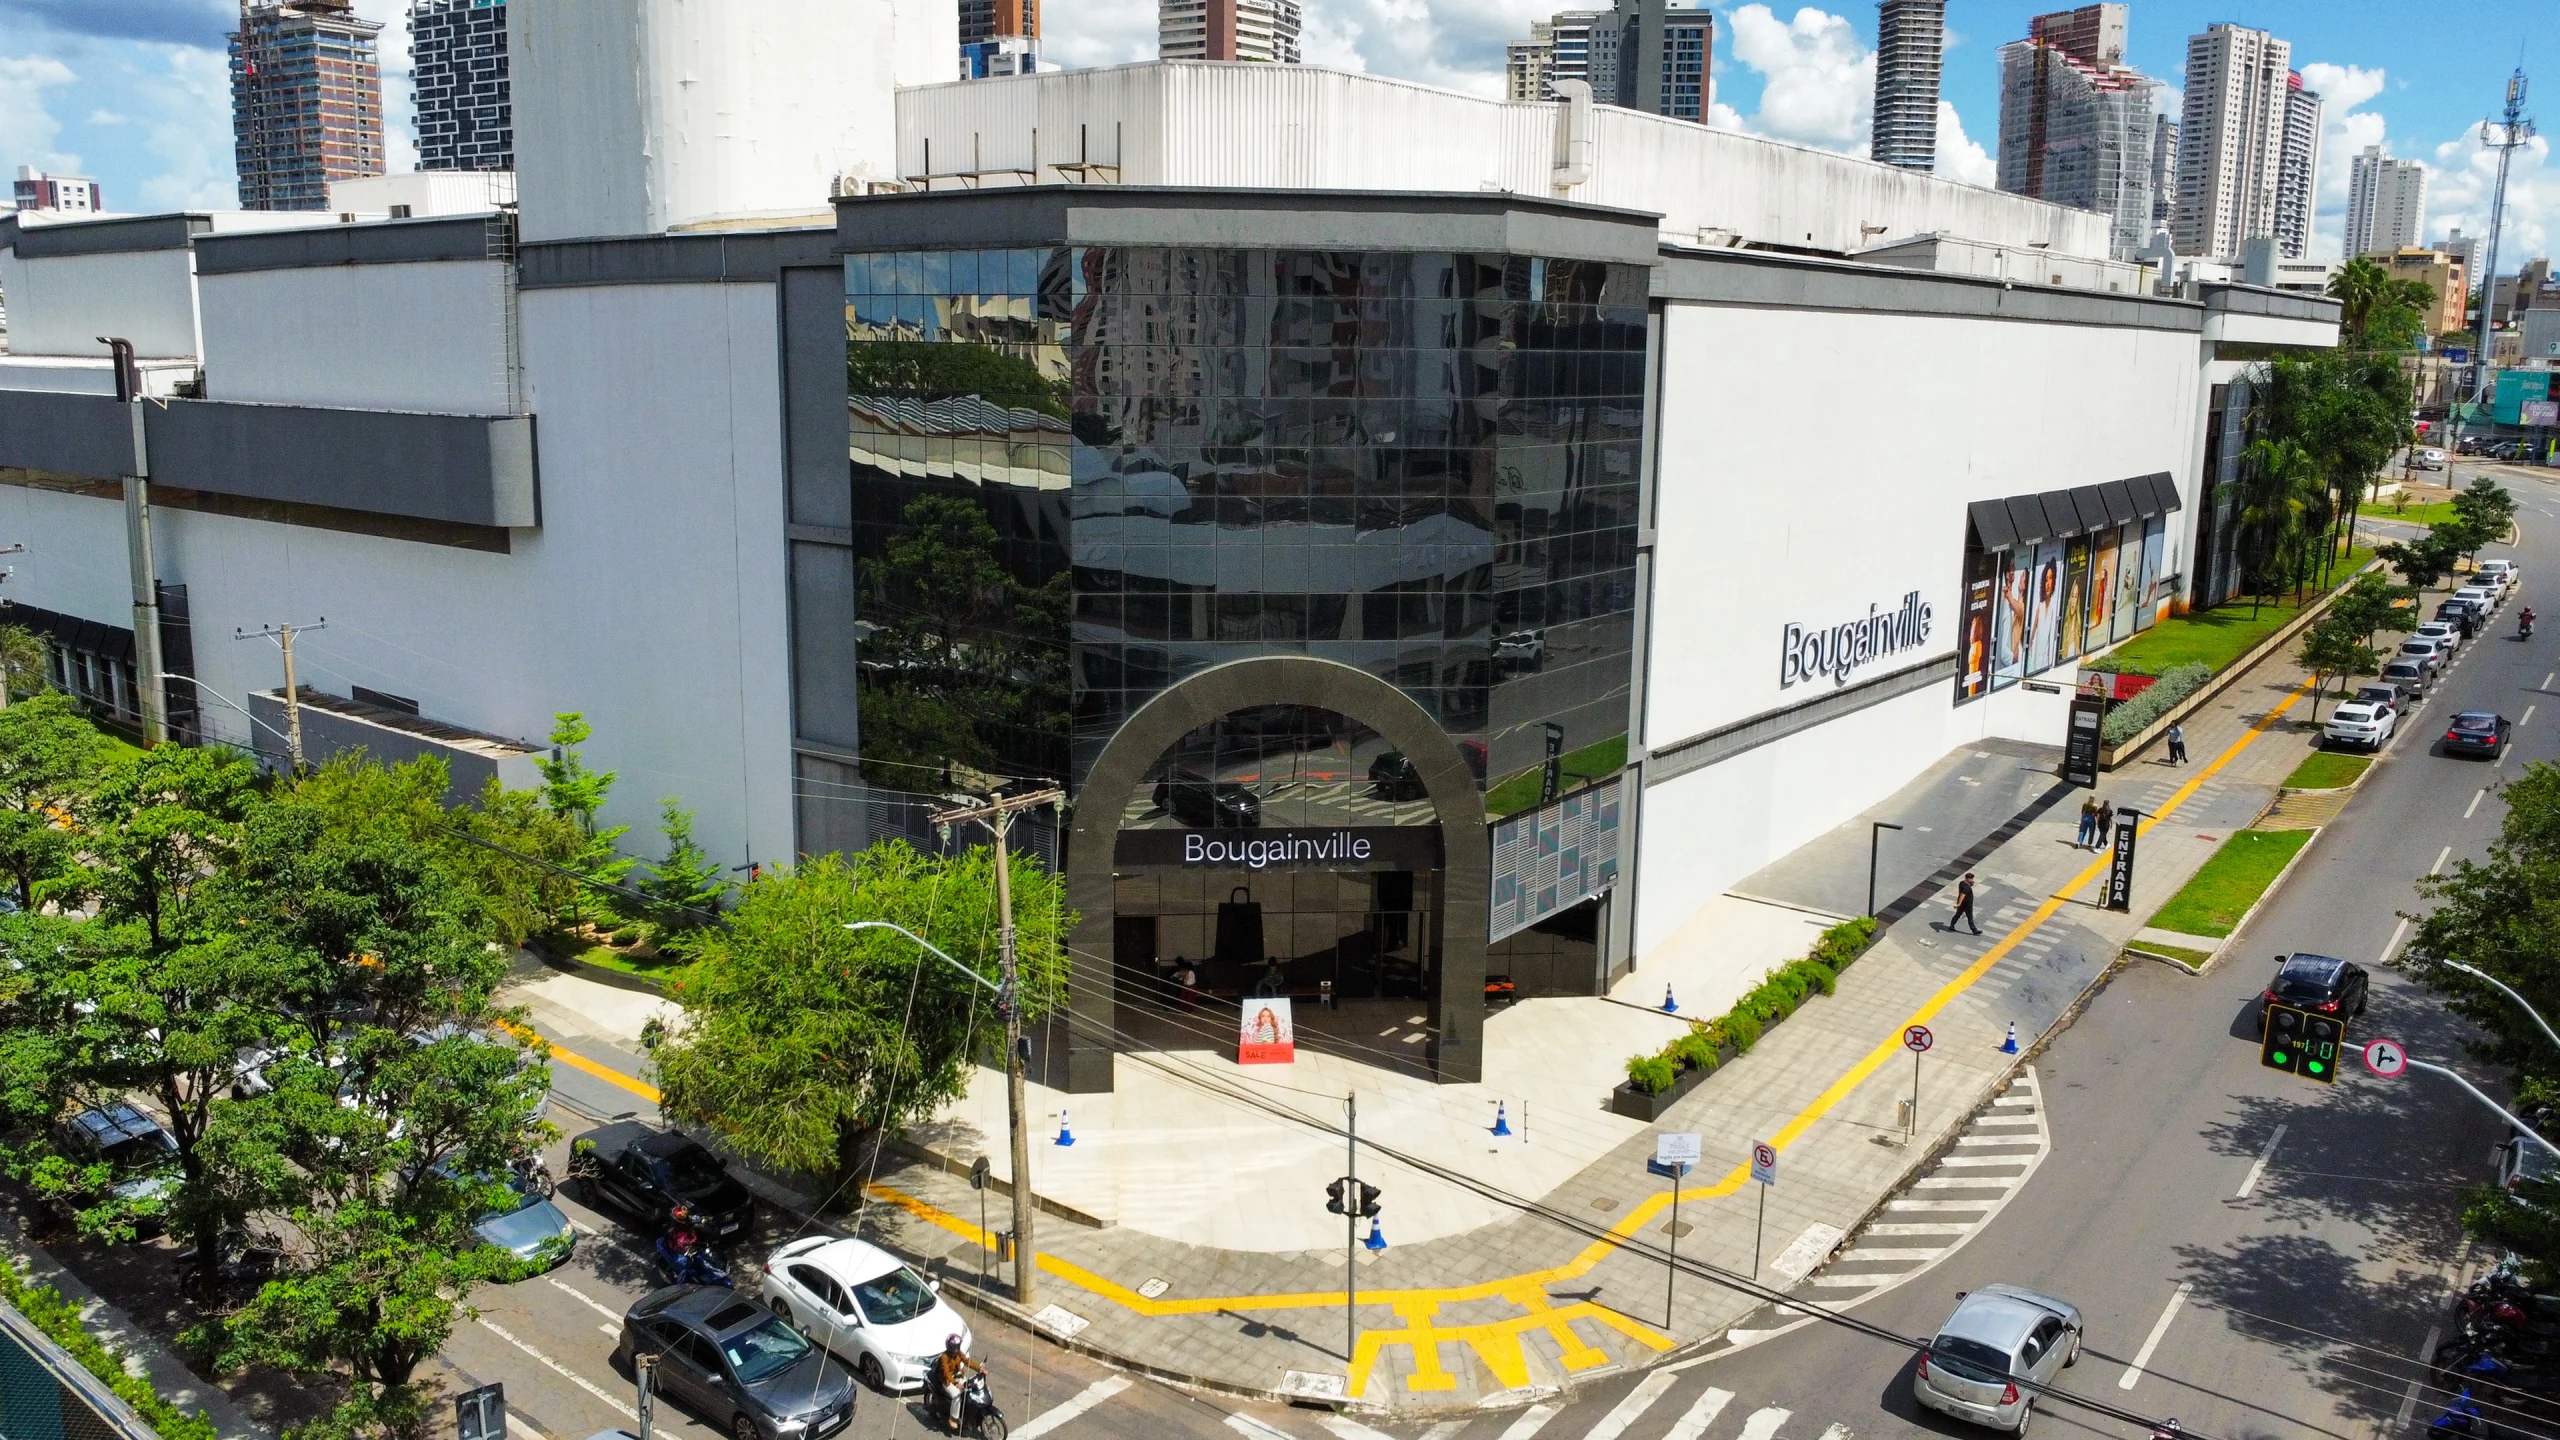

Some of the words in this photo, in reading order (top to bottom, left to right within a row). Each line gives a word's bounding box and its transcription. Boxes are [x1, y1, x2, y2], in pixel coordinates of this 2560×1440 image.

[1782, 590, 1933, 682] Bougainville
[2075, 715, 2096, 724] ENTRADA
[1185, 831, 1371, 868] Bougainville
[2112, 830, 2130, 902] ENTRADA
[1245, 1051, 1266, 1059] SALE
[2291, 1040, 2305, 1049] 197
